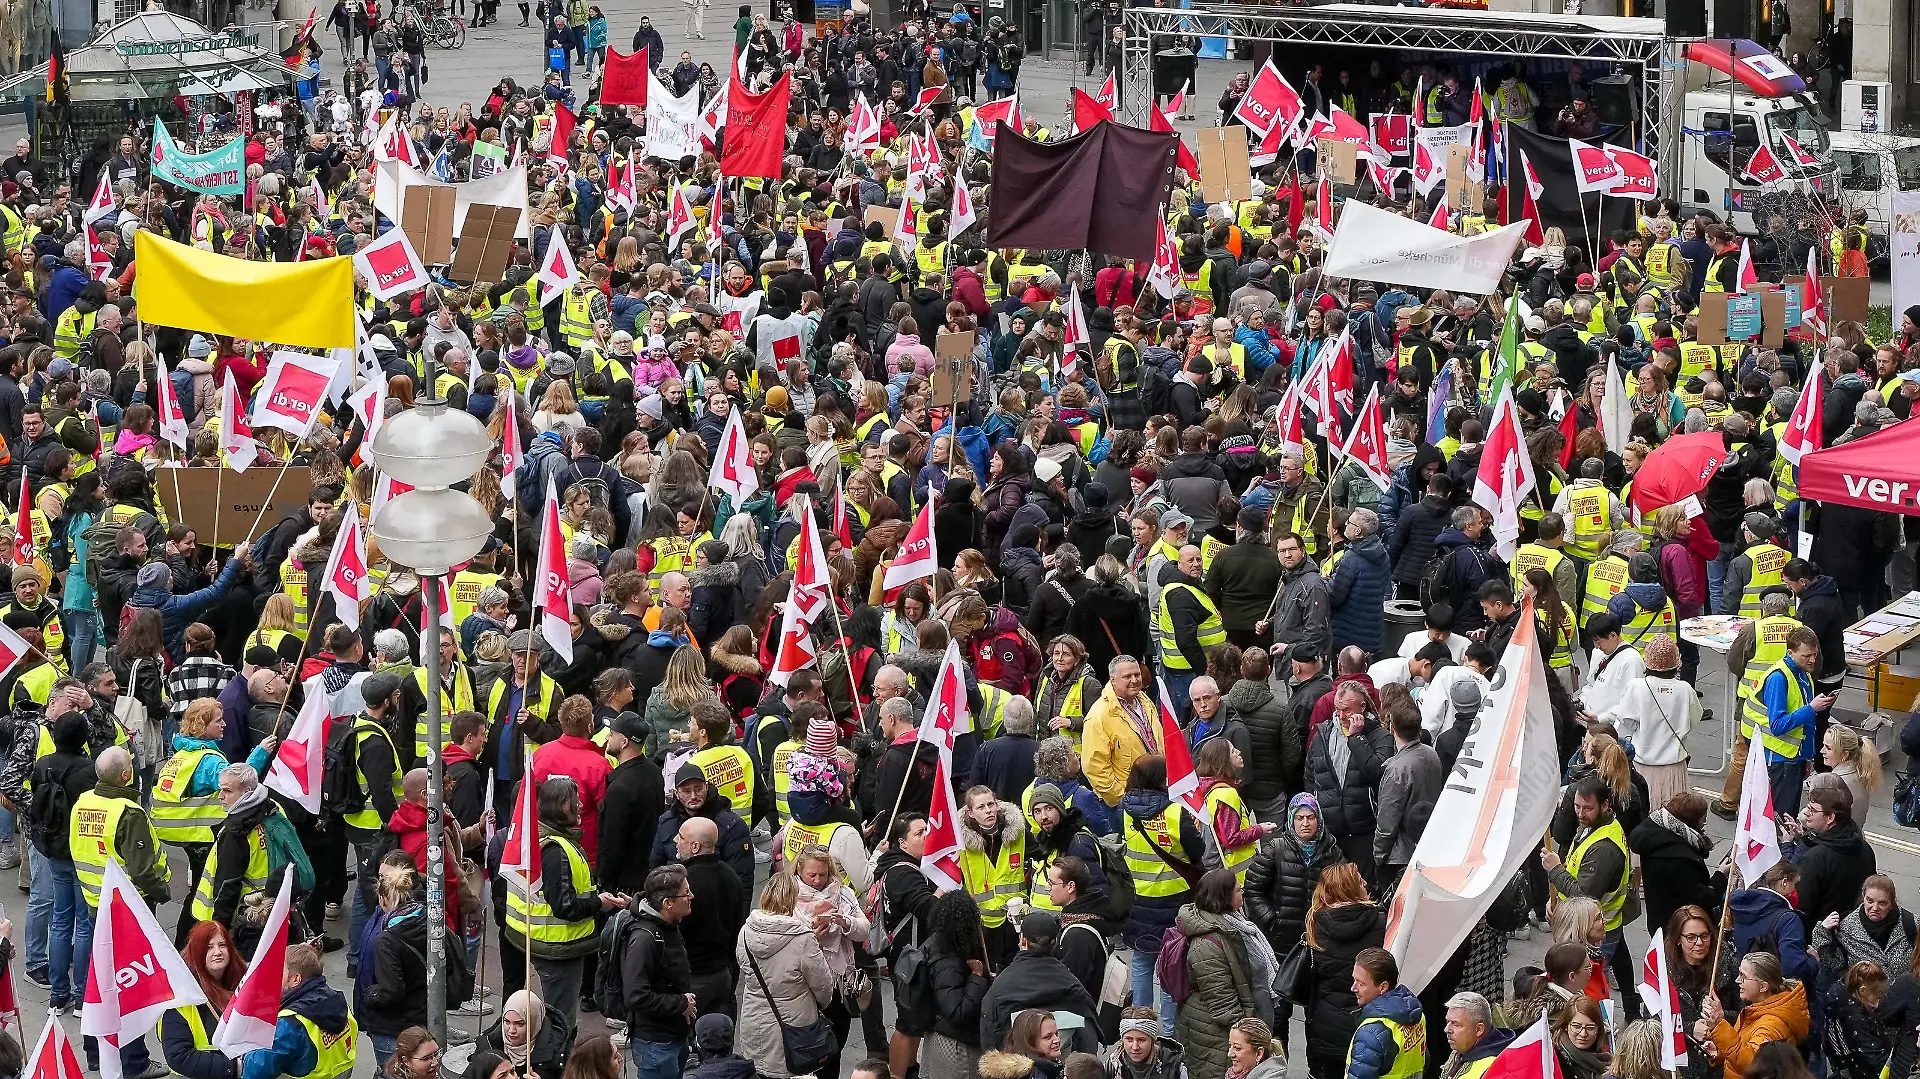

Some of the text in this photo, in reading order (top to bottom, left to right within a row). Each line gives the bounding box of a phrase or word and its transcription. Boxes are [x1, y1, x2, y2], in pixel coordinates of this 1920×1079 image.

[1624, 175, 1652, 189] er.di
[705, 758, 740, 778] ZUSAMMEN
[727, 767, 744, 783] MEHR
